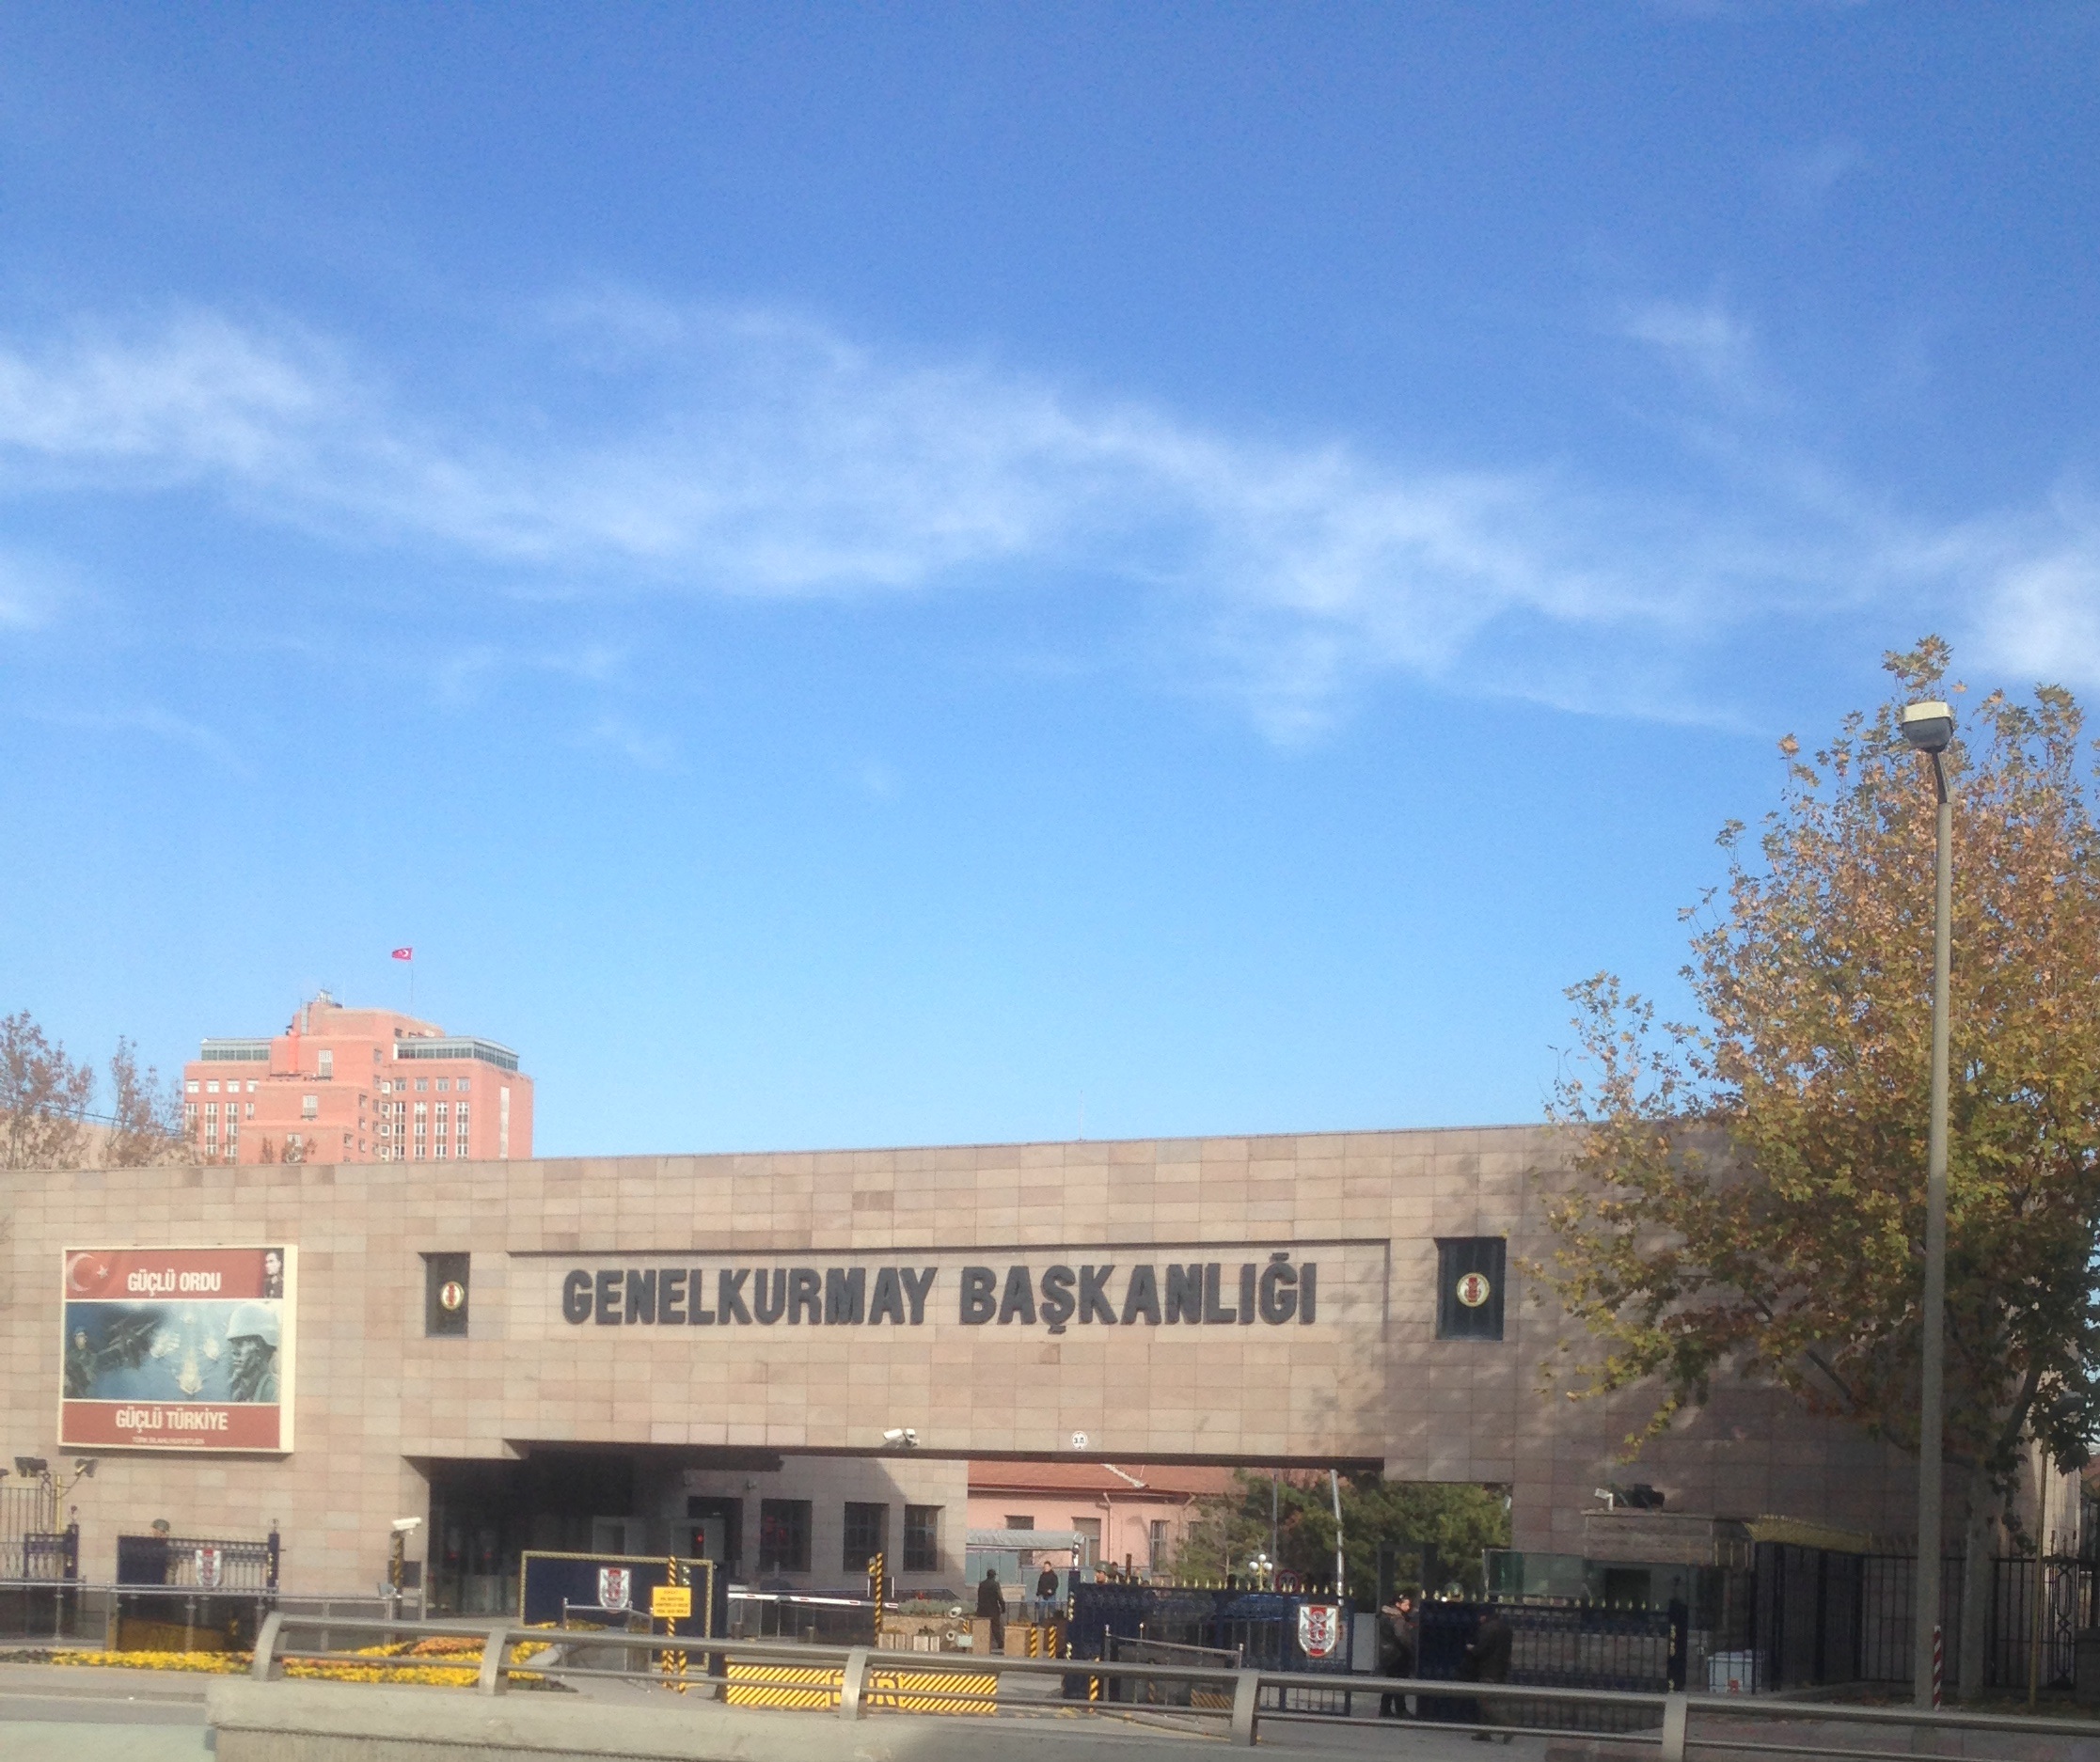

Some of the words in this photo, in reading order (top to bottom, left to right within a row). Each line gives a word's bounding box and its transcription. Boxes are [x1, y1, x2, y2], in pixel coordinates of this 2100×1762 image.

[127, 1268, 176, 1297] GÜÇLÜ
[179, 1272, 222, 1292] ORDU
[562, 1266, 939, 1326] GENELKURMAY
[958, 1251, 1317, 1335] BAŞKANLIĞI
[116, 1405, 163, 1434] GÜÇLÜ
[166, 1407, 229, 1430] TÜRKİYE
